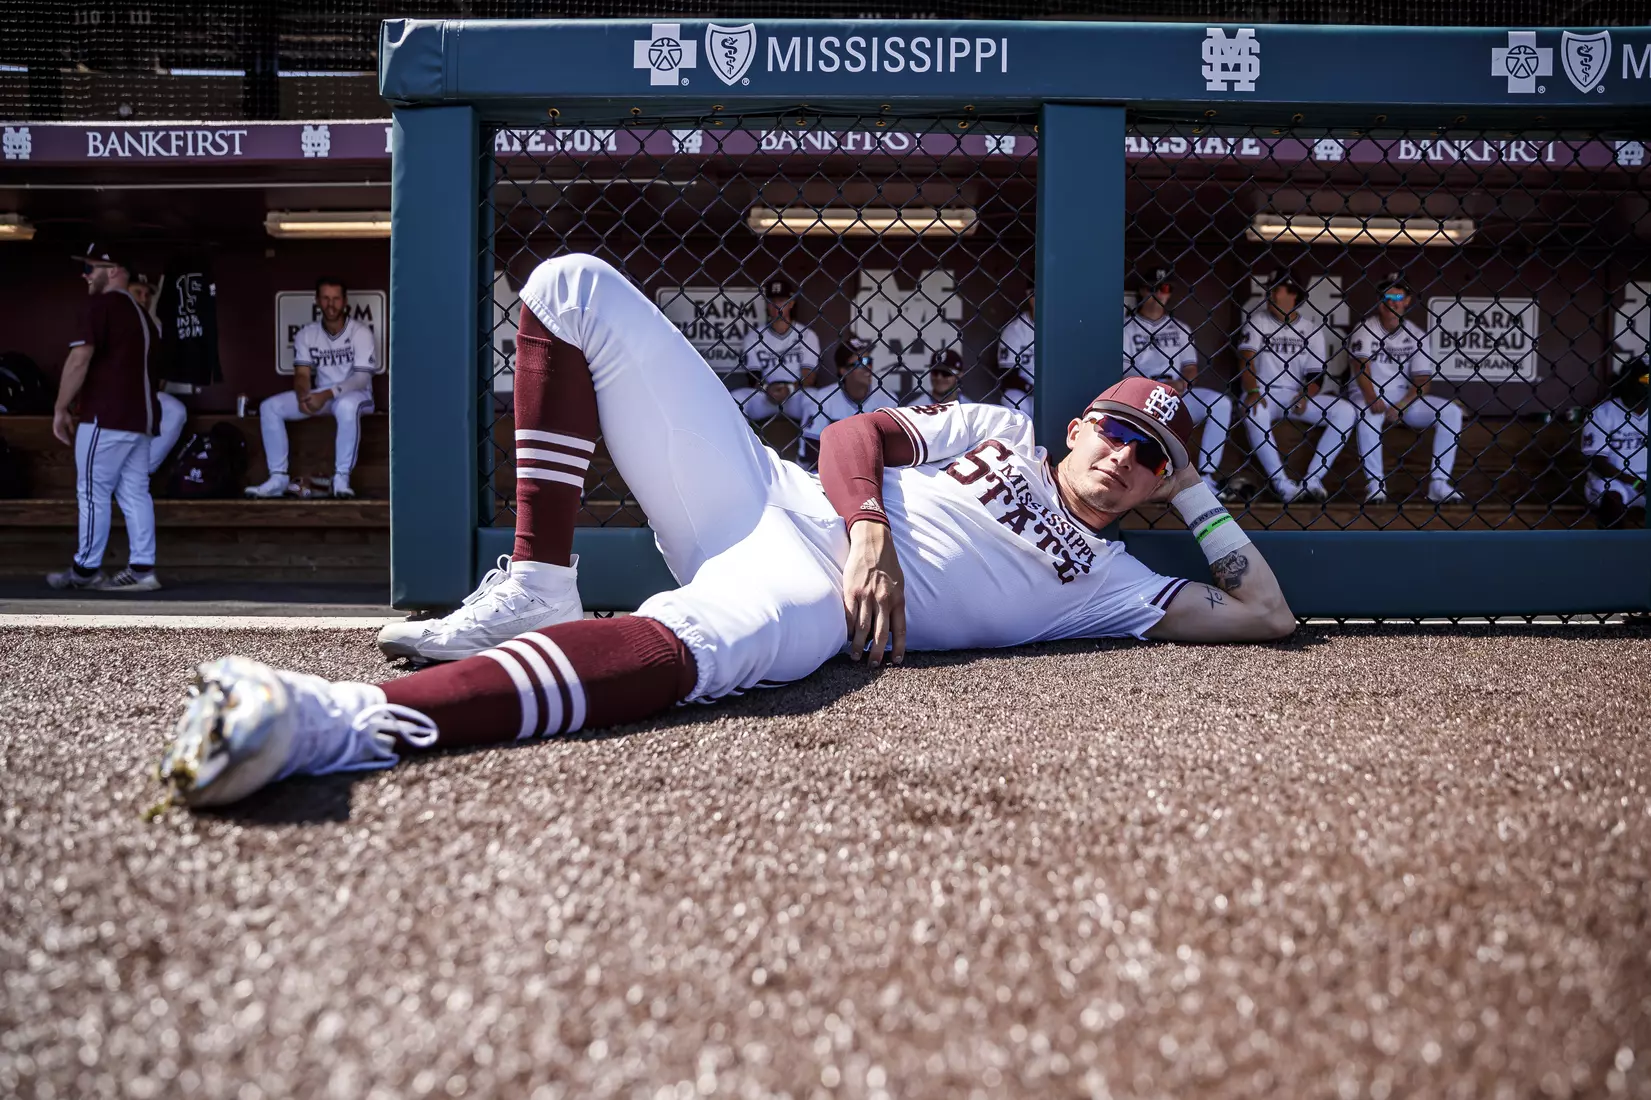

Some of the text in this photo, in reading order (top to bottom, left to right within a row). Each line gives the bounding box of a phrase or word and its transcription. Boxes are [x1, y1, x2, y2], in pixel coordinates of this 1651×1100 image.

[767, 36, 1008, 73] MISSISSIPPI
[86, 129, 248, 157] BANKFIRST
[312, 303, 373, 322] FM
[1464, 310, 1525, 329] FARM
[1440, 331, 1525, 350] BUREAU
[1454, 358, 1524, 371] INSURANE
[946, 438, 1091, 585] STATE
[998, 463, 1097, 567] MISSISSIPPI
